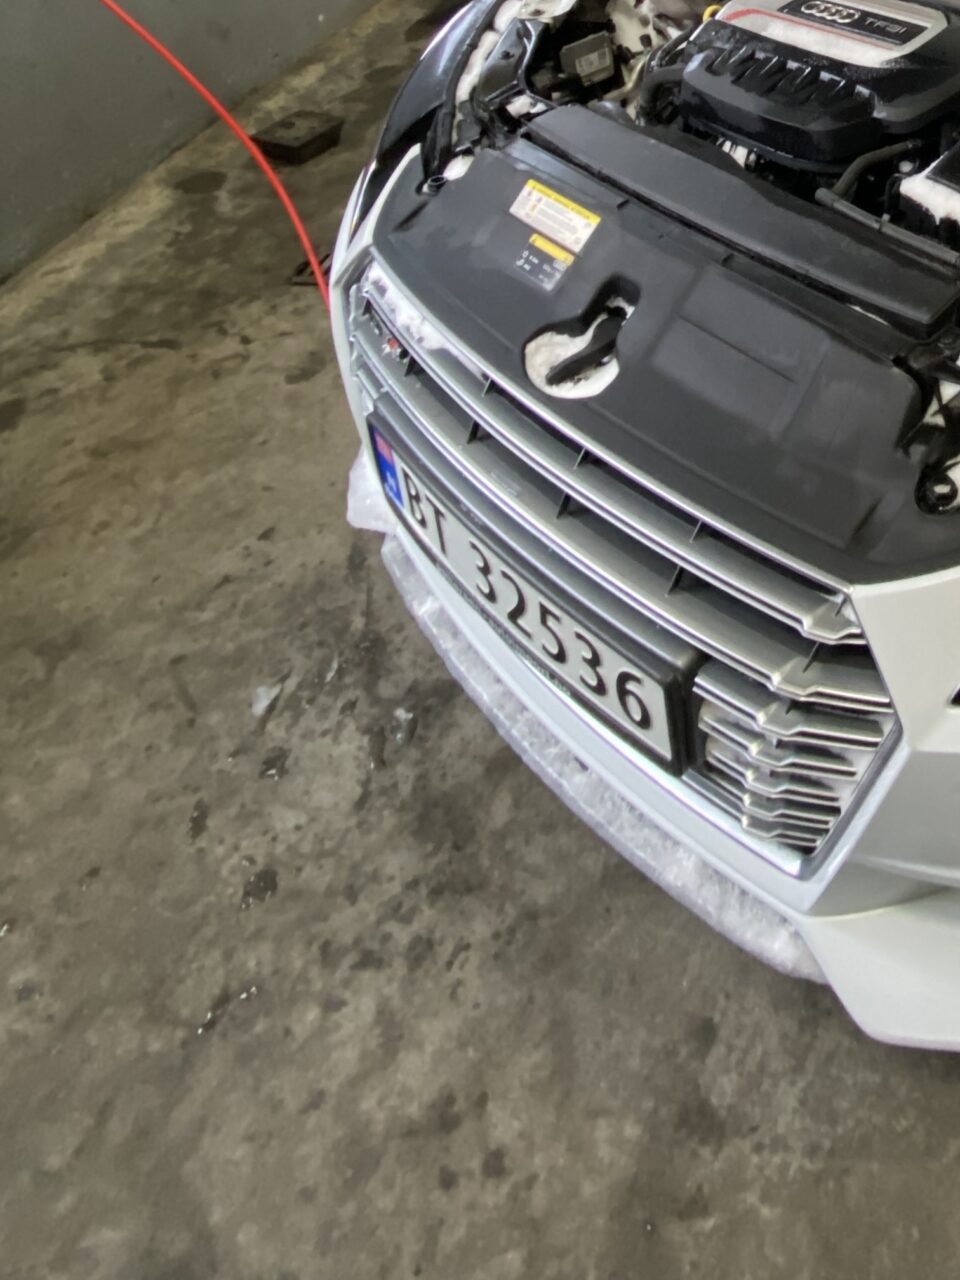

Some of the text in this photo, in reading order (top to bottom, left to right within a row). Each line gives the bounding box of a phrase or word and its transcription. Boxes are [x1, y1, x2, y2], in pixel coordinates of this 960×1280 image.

[865, 16, 908, 34] TFSI
[402, 464, 652, 730] BT 32536
